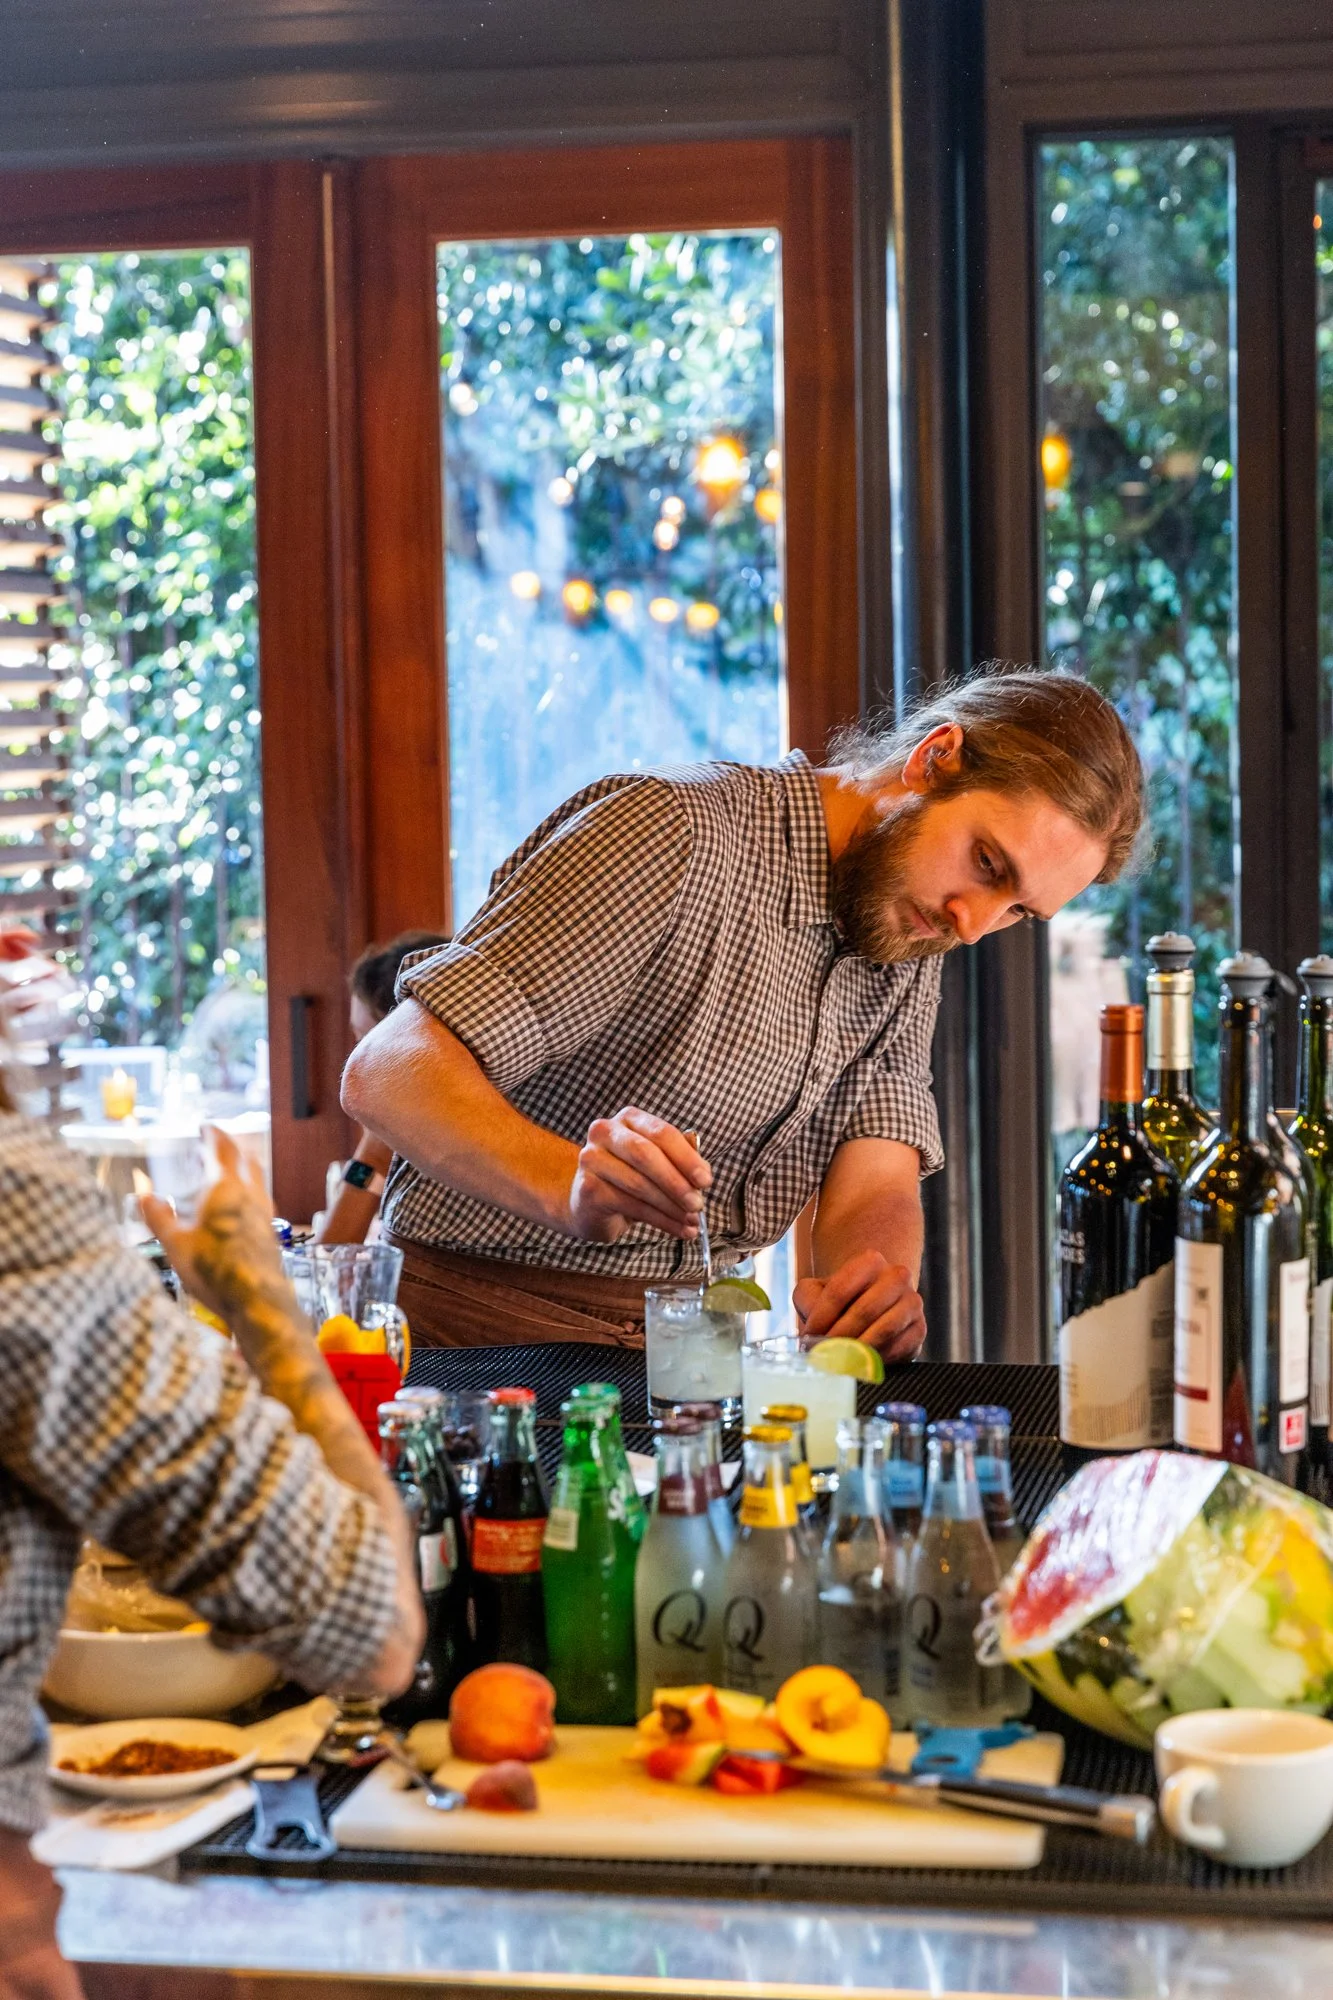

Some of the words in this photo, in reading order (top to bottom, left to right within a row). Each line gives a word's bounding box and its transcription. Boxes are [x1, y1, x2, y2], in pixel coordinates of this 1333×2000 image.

[653, 1589, 707, 1653] Q
[724, 1596, 765, 1661] Q
[908, 1593, 943, 1661] Q
